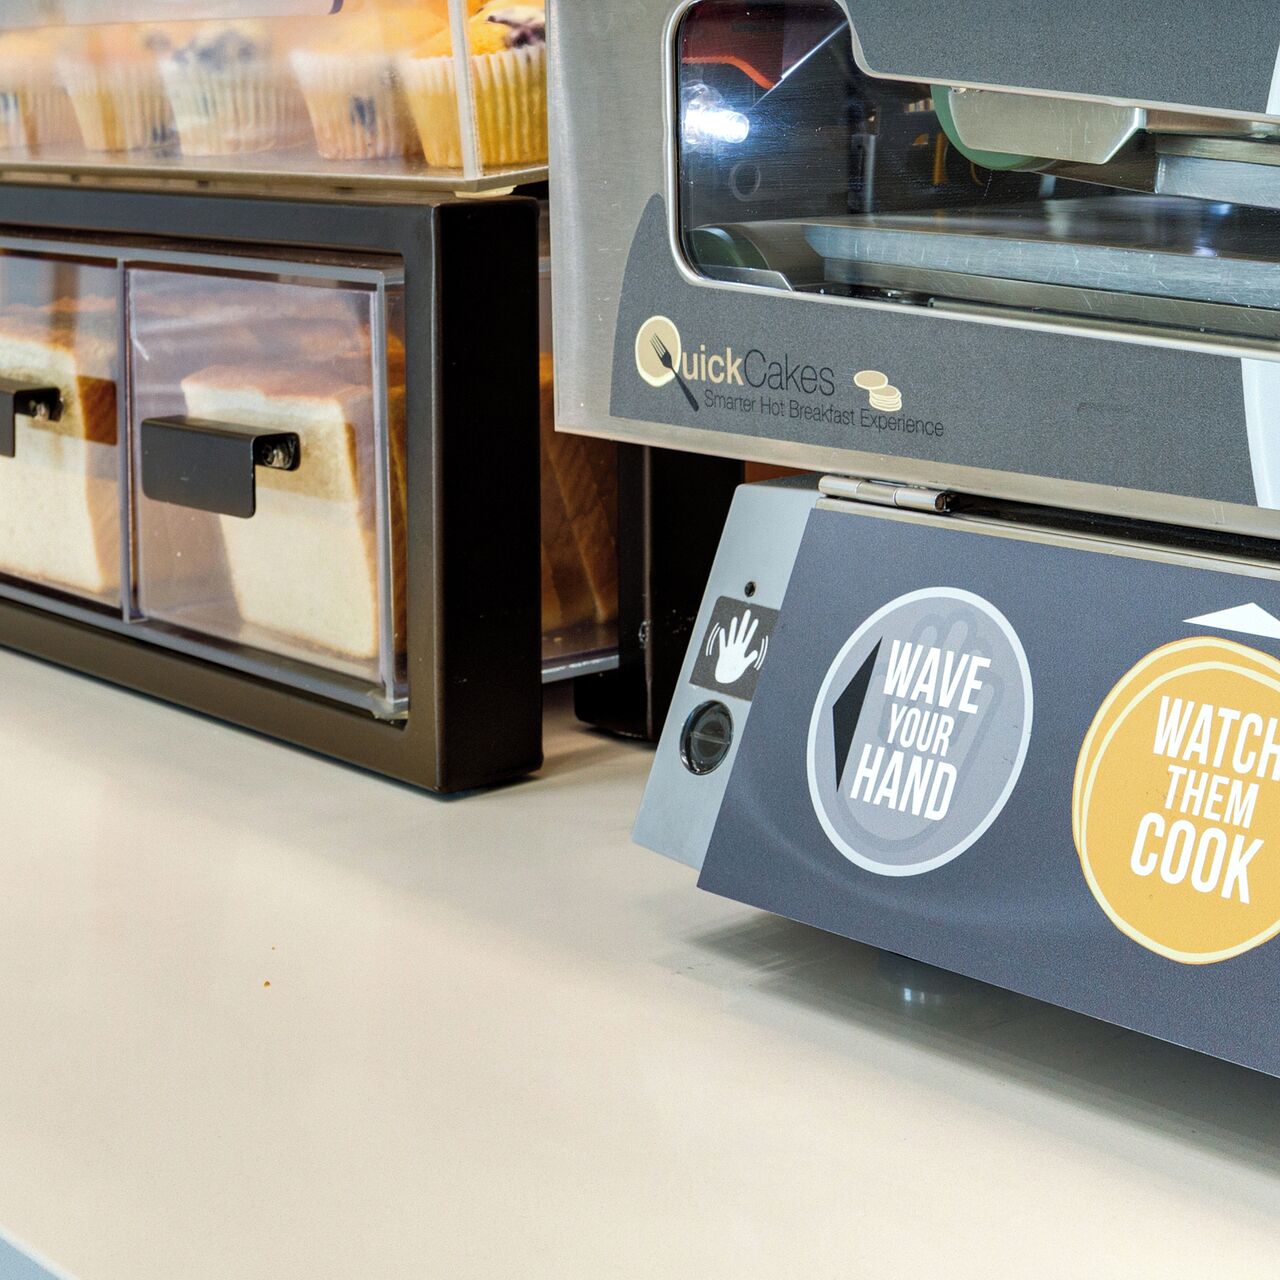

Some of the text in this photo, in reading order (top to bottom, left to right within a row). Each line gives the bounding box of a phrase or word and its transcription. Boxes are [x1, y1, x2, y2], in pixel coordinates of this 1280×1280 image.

[703, 388, 945, 438] Smarter Hot Breakfast Experience
[883, 639, 992, 716] WAVE
[887, 703, 955, 757] YOUR
[849, 743, 958, 822] HAND
[1164, 764, 1260, 829] THEM
[1129, 812, 1265, 904] COOK
